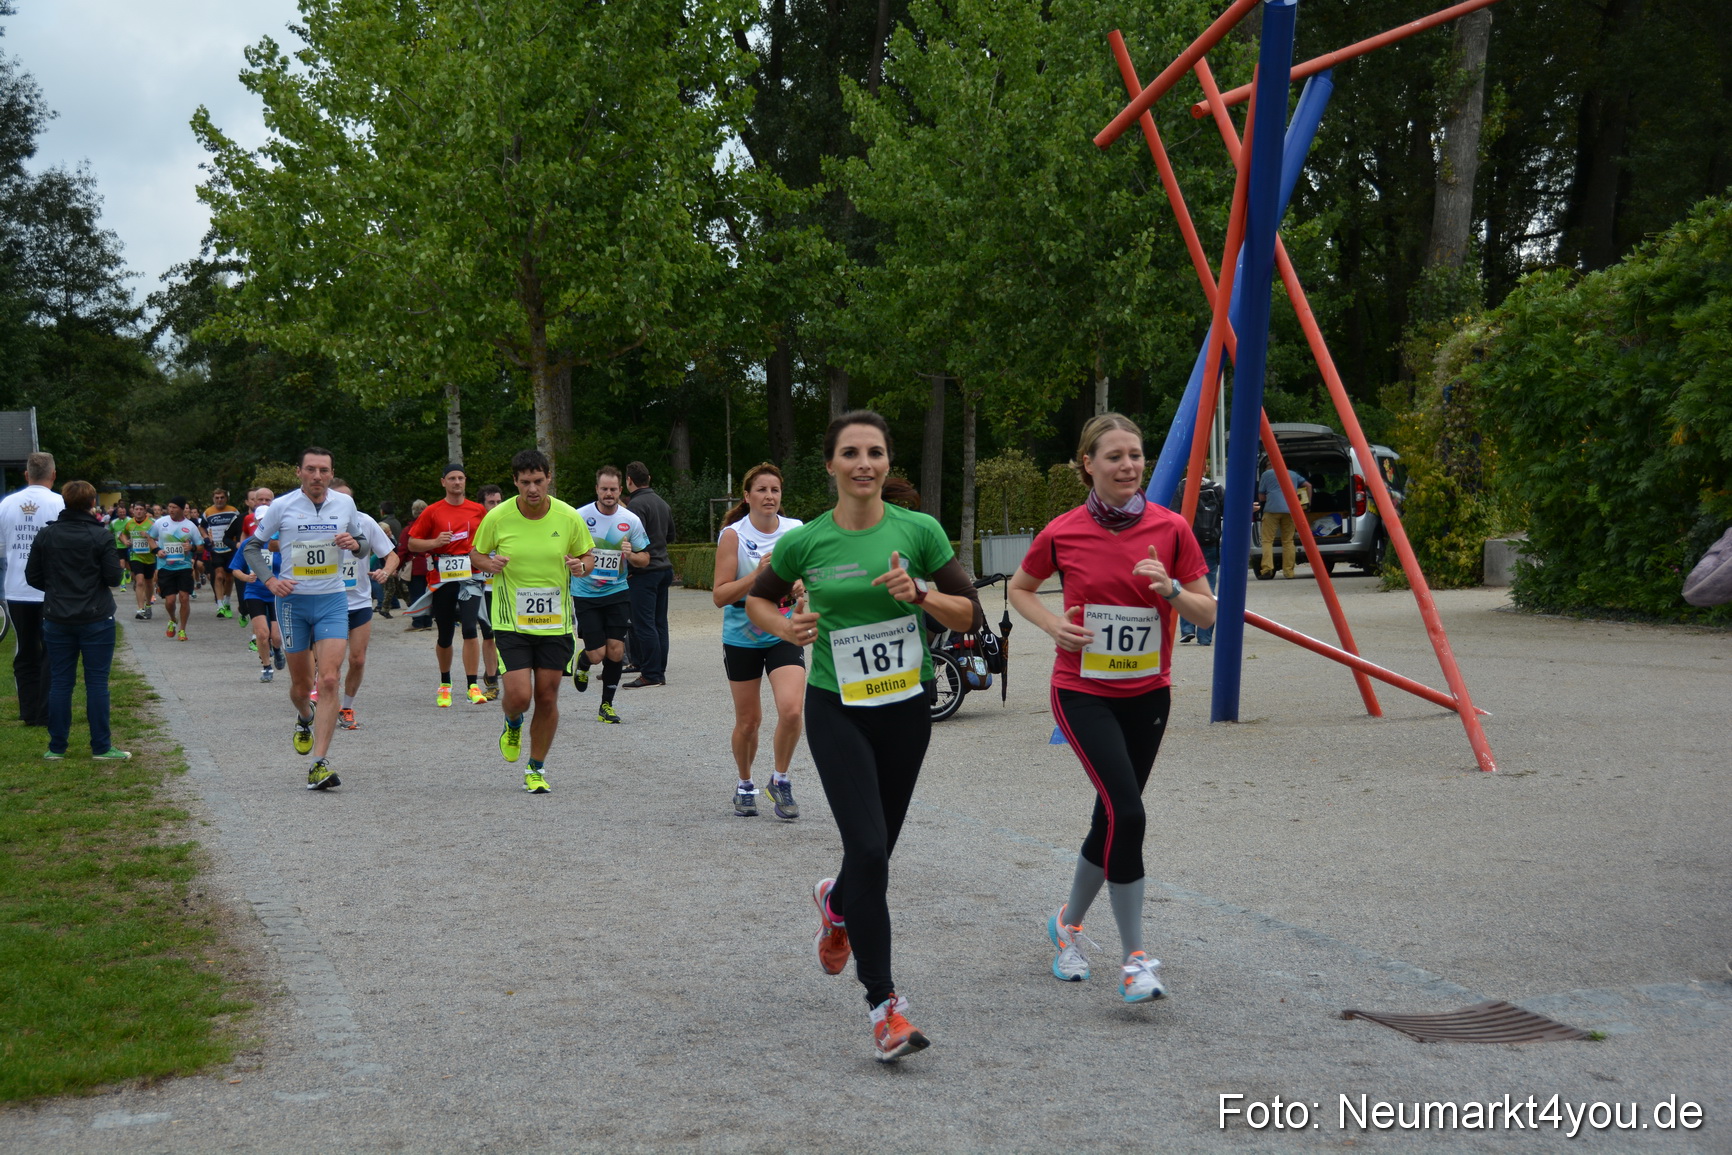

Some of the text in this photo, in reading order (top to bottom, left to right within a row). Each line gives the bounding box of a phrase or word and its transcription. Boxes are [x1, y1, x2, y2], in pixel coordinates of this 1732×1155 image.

[15, 524, 41, 532] AUFTRA
[307, 549, 325, 565] 80
[445, 559, 464, 570] 237
[594, 555, 618, 569] 2126
[526, 597, 552, 613] 261
[527, 616, 552, 624] Michael
[1086, 611, 1154, 623] PARTL Neumarkt
[833, 626, 905, 647] PARTL Neumarkt
[1101, 624, 1151, 652] 167
[852, 638, 905, 675] 187
[1108, 658, 1138, 669] Anika
[865, 677, 907, 695] Bettina
